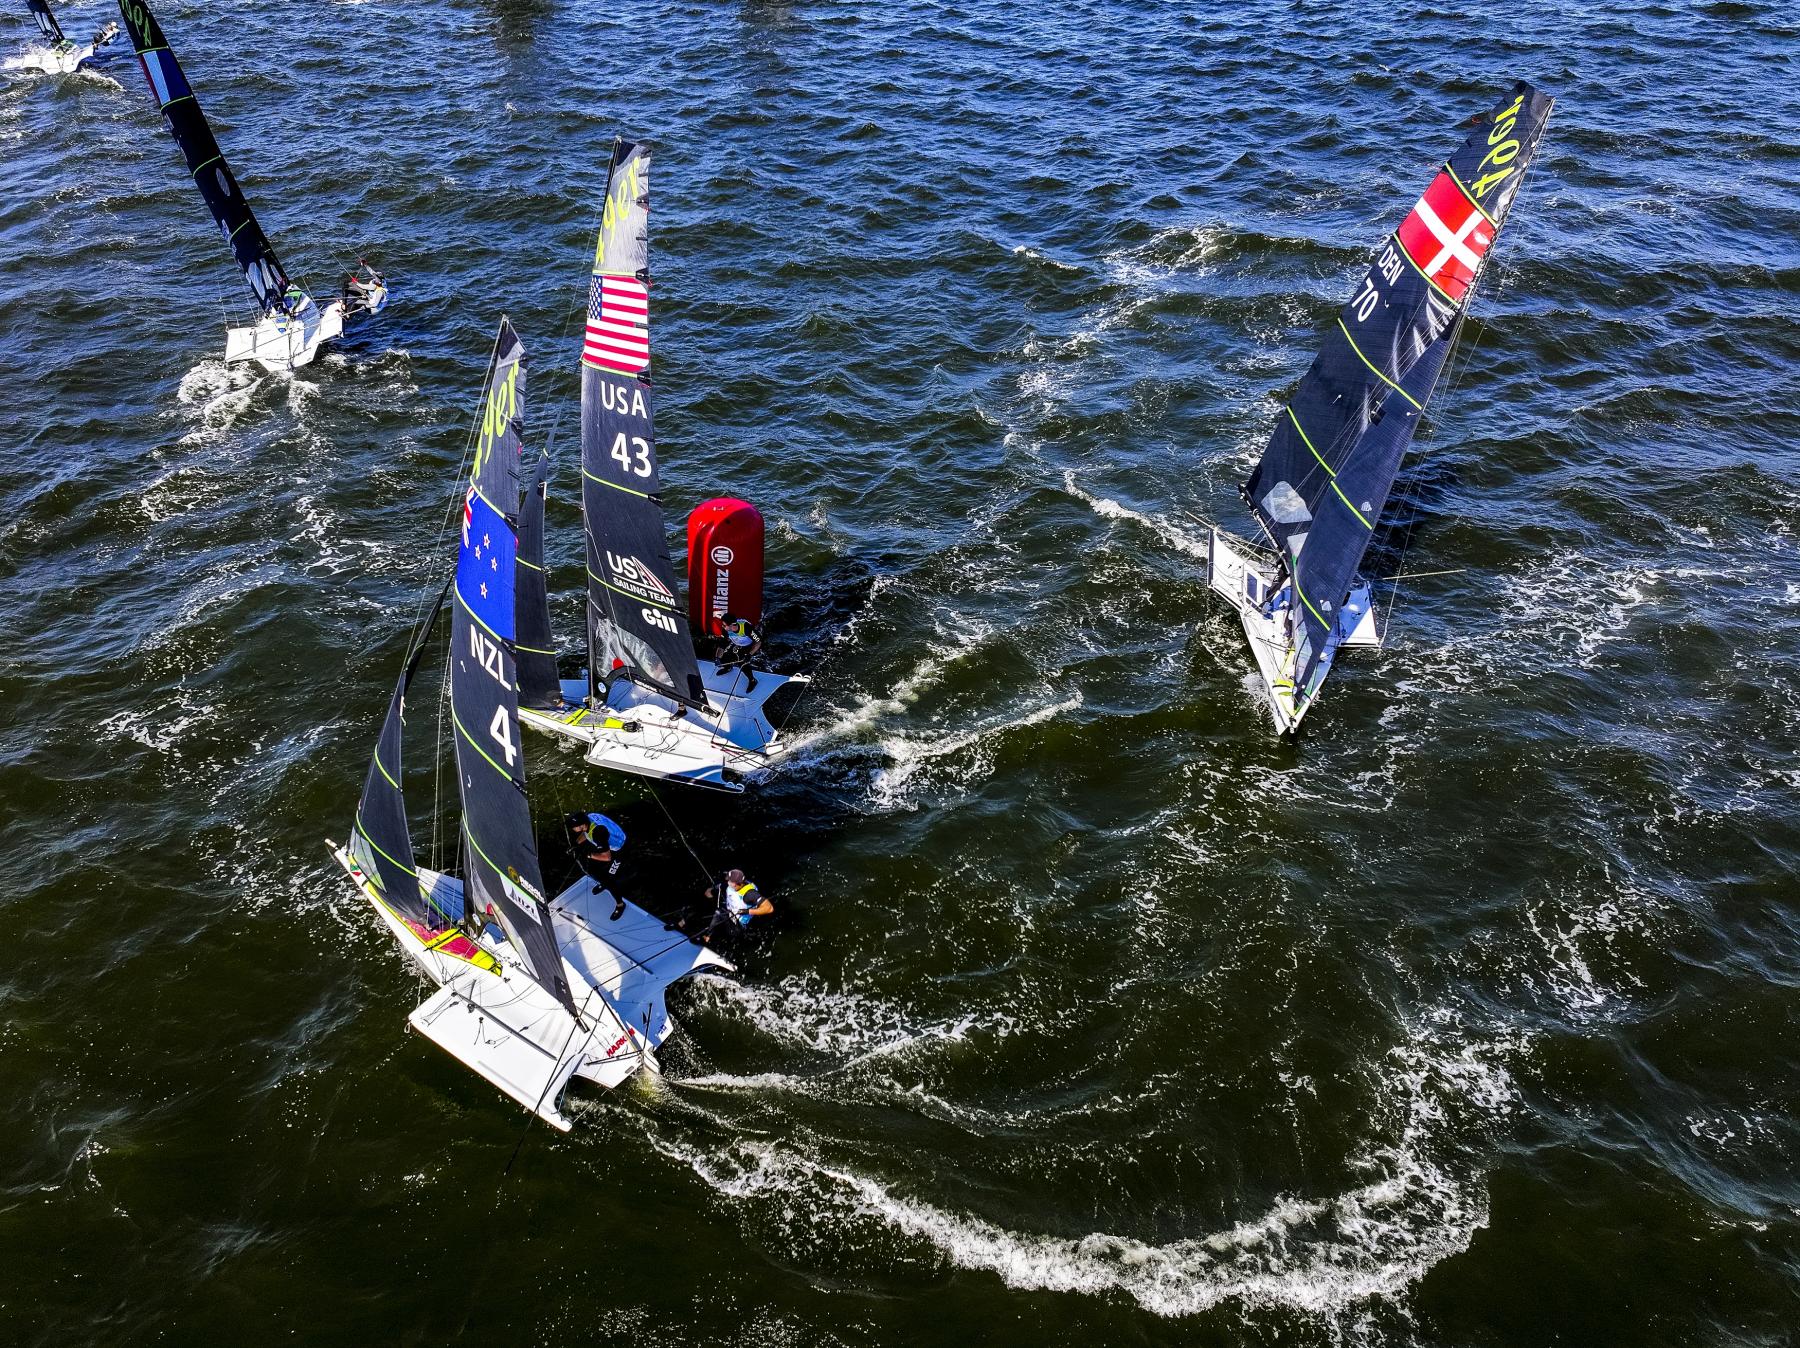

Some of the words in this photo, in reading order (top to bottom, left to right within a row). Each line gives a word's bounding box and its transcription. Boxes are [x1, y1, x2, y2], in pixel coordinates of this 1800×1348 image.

[1377, 247, 1405, 287] DEN
[1351, 277, 1379, 322] 70
[599, 380, 648, 419] USA
[610, 431, 652, 478] 43
[612, 577, 648, 597] SAILING
[648, 590, 676, 607] TEAM
[712, 568, 729, 620] Allianz
[641, 608, 679, 635] Gill
[469, 623, 512, 691] NZL
[489, 704, 518, 768] 4
